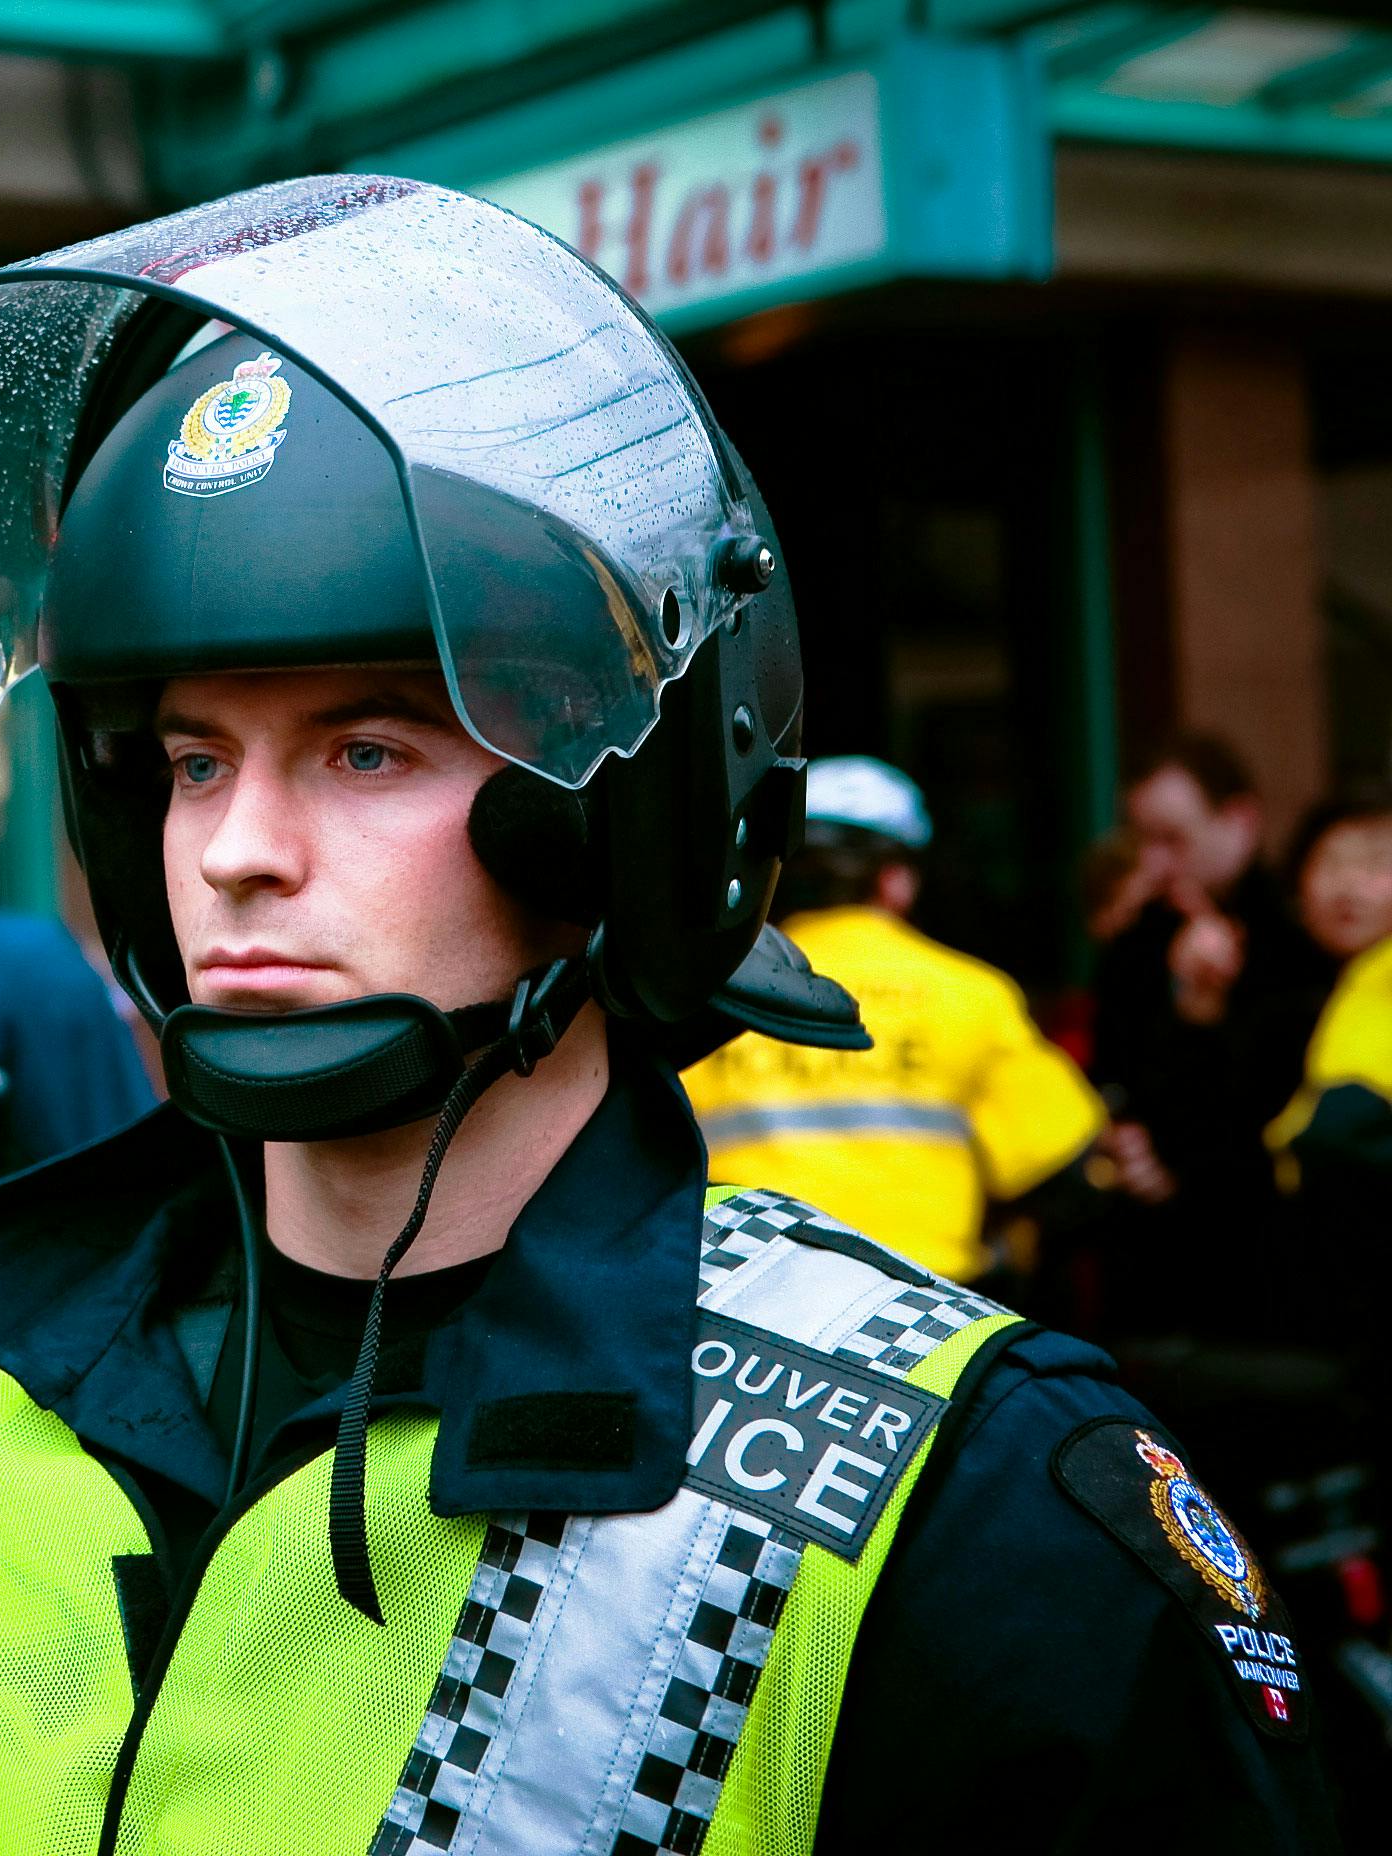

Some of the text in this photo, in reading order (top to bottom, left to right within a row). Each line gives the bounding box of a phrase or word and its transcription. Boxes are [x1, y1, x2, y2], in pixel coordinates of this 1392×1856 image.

[578, 116, 860, 297] Hair
[167, 466, 264, 491] CROWD CONTROL UNIT
[1214, 1624, 1297, 1667] POLICE
[1232, 1658, 1301, 1692] VANCOUVER
